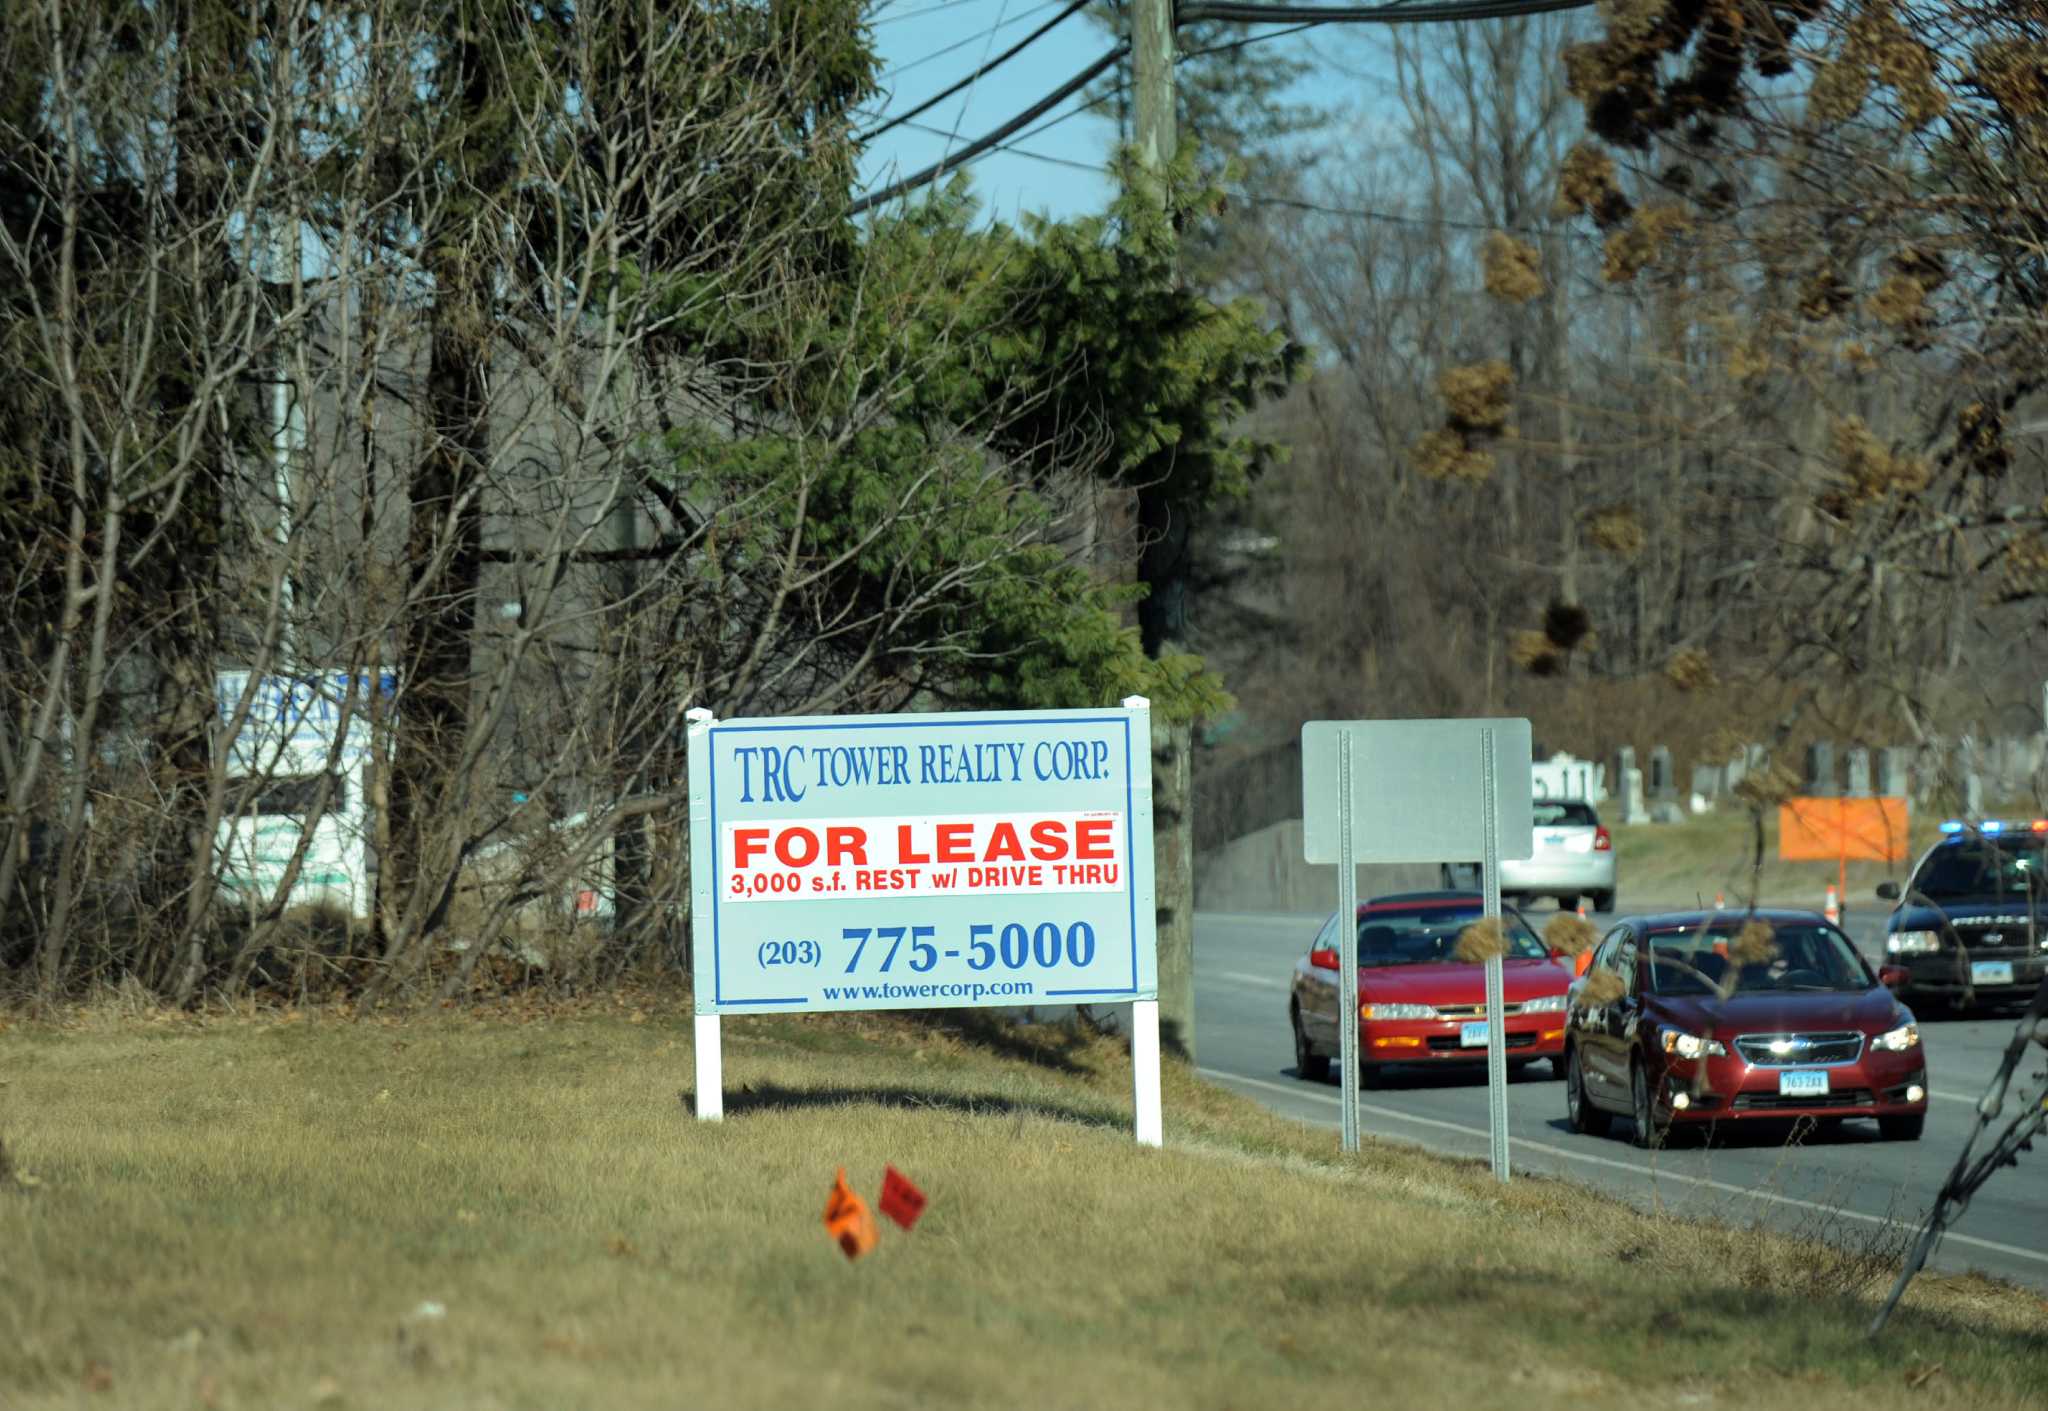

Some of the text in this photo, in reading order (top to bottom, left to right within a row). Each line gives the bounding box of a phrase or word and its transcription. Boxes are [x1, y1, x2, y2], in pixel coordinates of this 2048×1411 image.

[734, 740, 1110, 803] TRC TOWER REALTY CORP.
[733, 820, 1115, 869] FOR LEASE
[731, 863, 1120, 898] 3,000 s.f. REST w/ DRIVE THRU
[757, 940, 823, 969] (203)
[822, 979, 1035, 1003] www.towercorp.com
